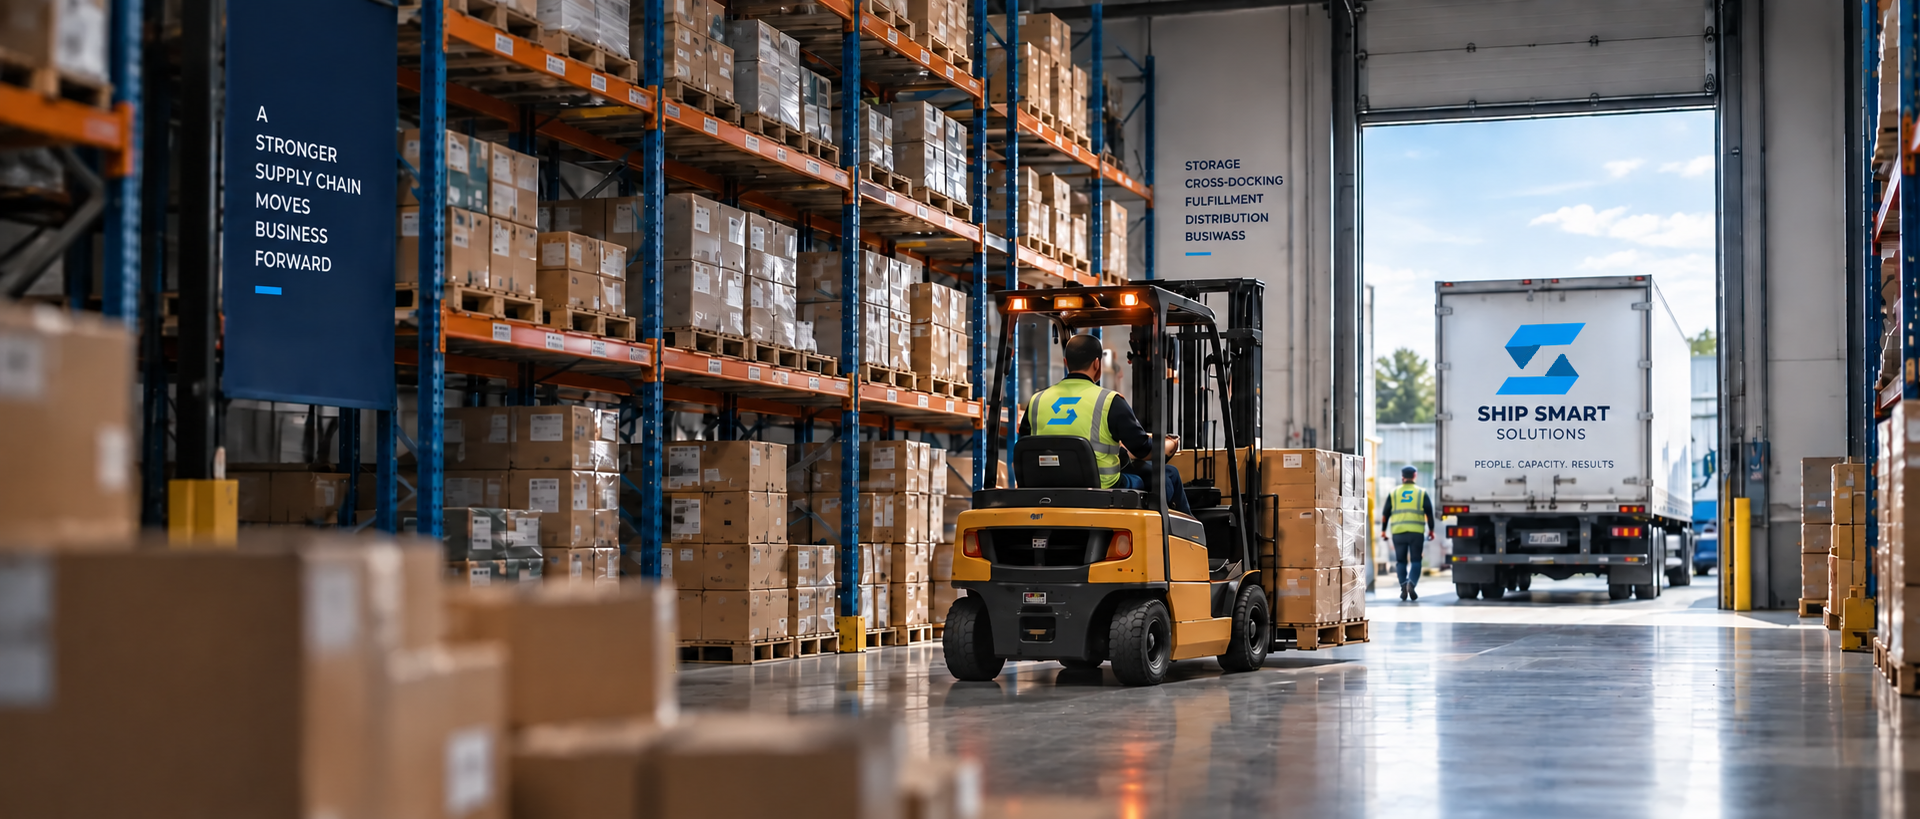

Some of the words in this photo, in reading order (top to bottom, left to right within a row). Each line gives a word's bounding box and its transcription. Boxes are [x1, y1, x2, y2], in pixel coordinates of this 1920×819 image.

[256, 105, 268, 123] A
[255, 134, 337, 163] STRONGER
[1185, 159, 1241, 171] STORAGE
[255, 163, 313, 186] SUPPLY
[316, 173, 361, 195] CHAIN
[1185, 175, 1284, 189] CROSS-DOCKING
[255, 192, 311, 215] MOVES
[1185, 193, 1264, 207] FULFILLMENT
[1185, 212, 1269, 225] DISTRIBUTION
[255, 221, 328, 244] BUSINESS
[1185, 230, 1246, 242] BUSIWASS
[255, 250, 332, 272] FORWARD
[1477, 405, 1529, 422] SHIP
[1534, 405, 1611, 422] SMART
[1496, 428, 1586, 440] SOLUTIONS
[1474, 460, 1515, 469] PEOPLE.
[1517, 460, 1568, 469] CAPACITY.
[1571, 460, 1615, 469] RESULTS
